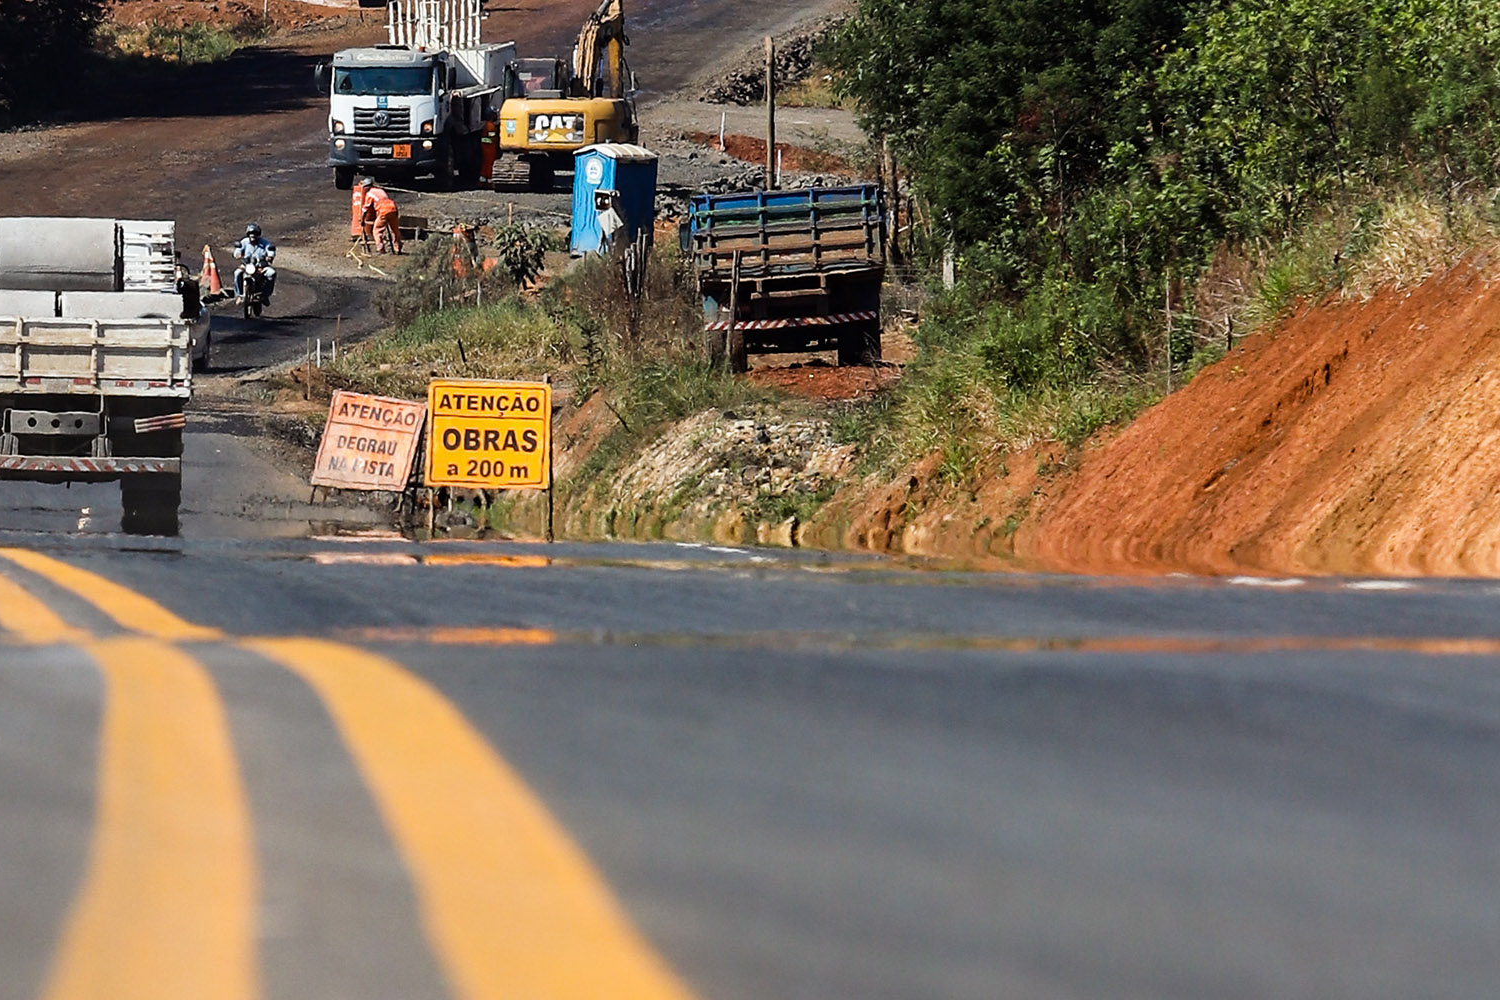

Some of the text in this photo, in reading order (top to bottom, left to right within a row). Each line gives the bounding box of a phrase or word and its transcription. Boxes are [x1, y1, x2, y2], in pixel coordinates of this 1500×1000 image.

[534, 115, 579, 141] CAT
[338, 402, 416, 428] ATENÇÃO
[439, 392, 540, 417] ATENÇÃO
[337, 434, 398, 456] DEGRAU
[442, 428, 538, 453] OBRAS
[327, 455, 348, 472] NA
[446, 459, 529, 479] a 200 m
